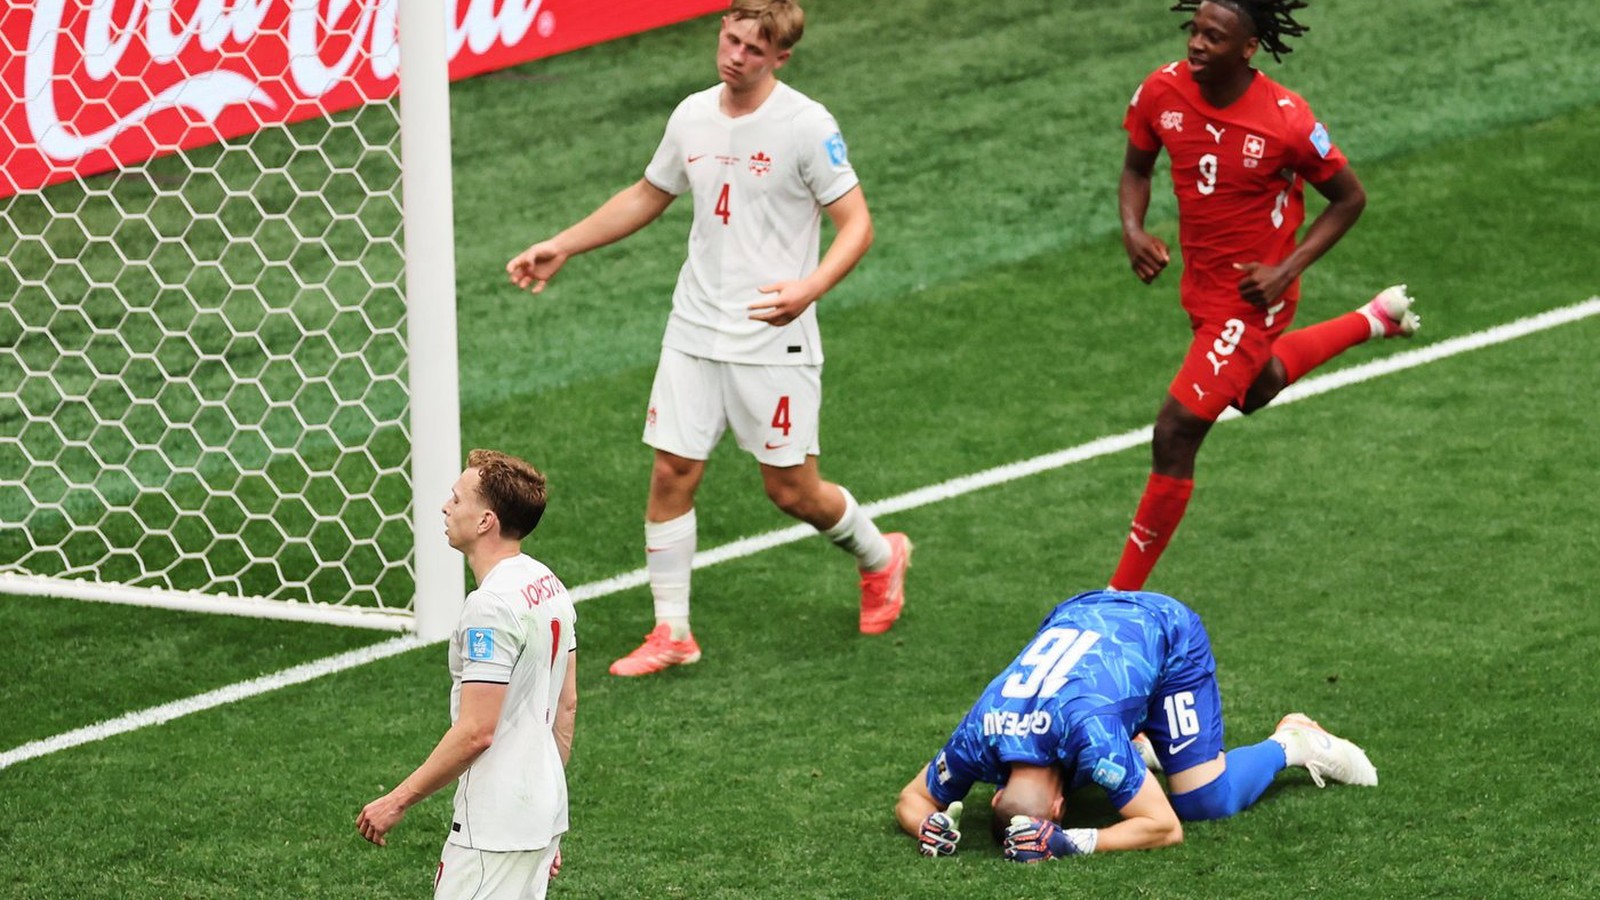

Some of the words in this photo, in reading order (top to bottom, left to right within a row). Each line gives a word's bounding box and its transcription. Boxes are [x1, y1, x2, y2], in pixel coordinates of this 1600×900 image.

[1197, 154, 1218, 195] 9
[714, 183, 731, 225] 4
[1213, 318, 1245, 356] 9
[771, 396, 791, 436] 4
[1001, 627, 1102, 698] 16
[1163, 691, 1200, 739] 16
